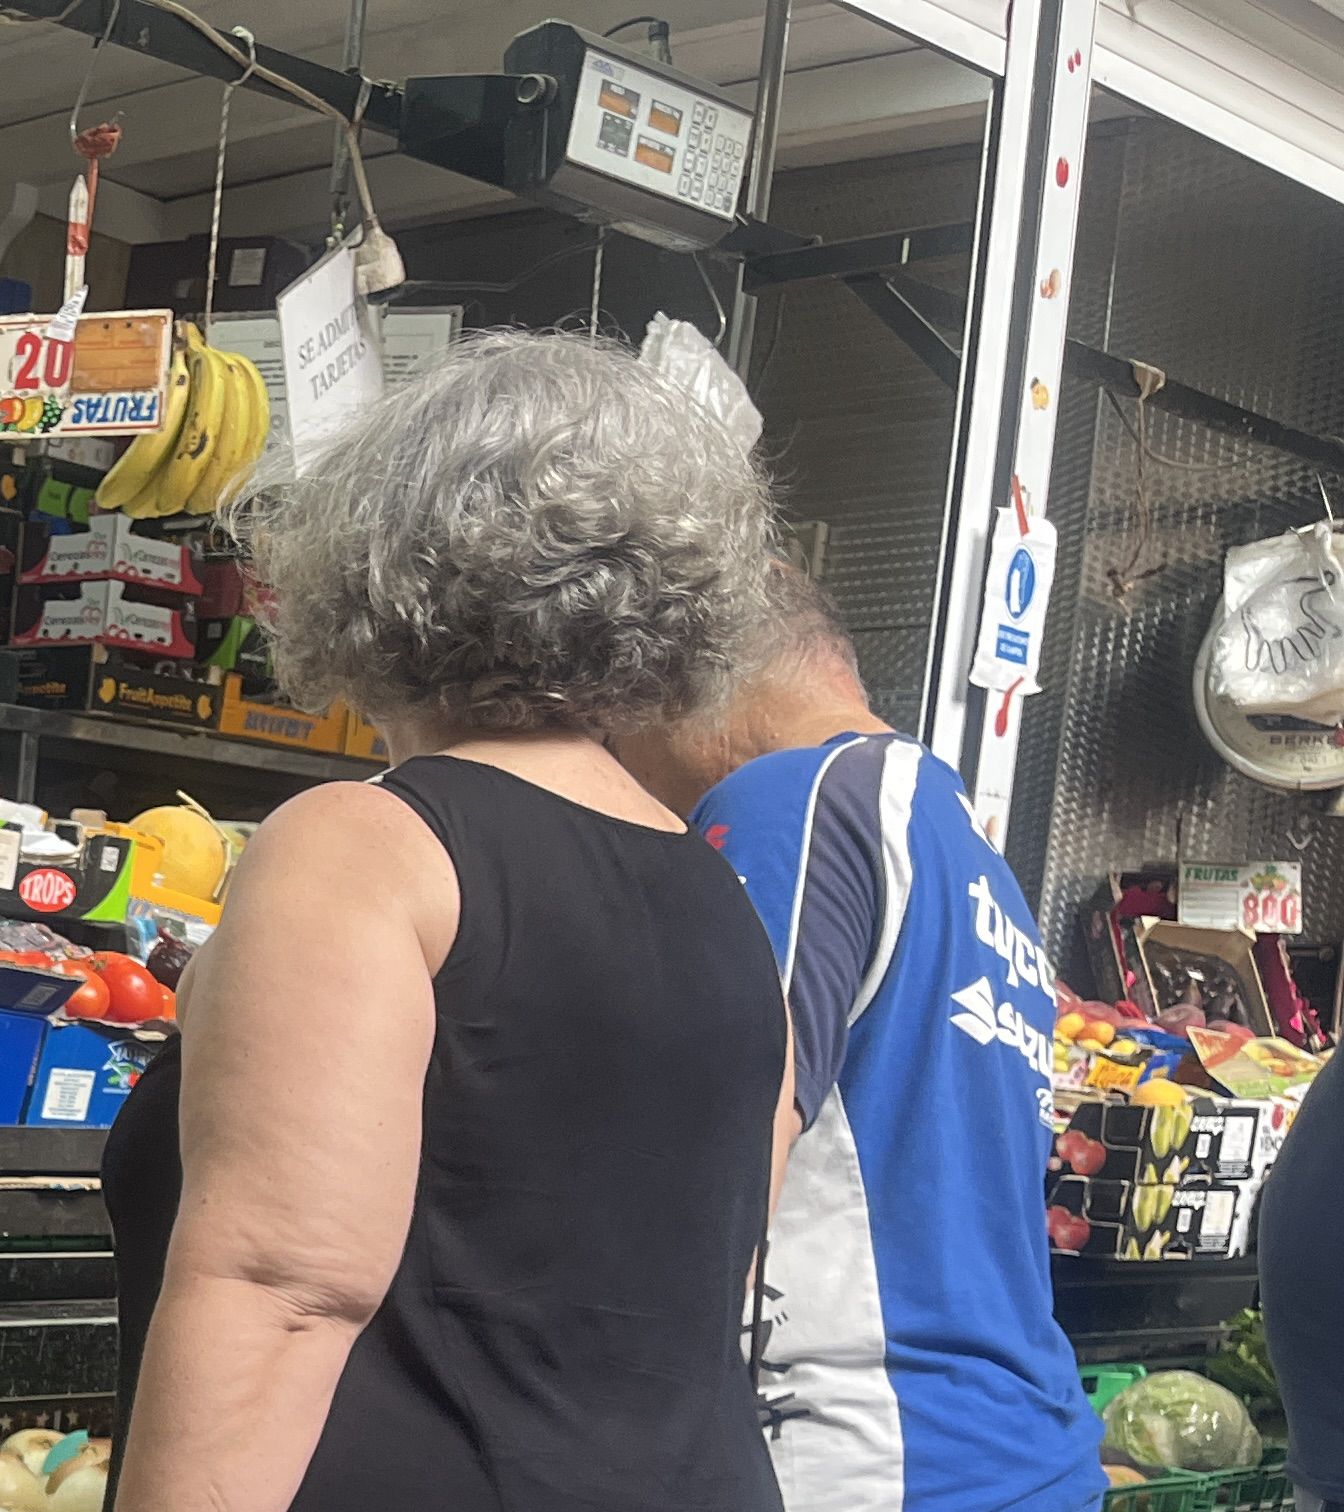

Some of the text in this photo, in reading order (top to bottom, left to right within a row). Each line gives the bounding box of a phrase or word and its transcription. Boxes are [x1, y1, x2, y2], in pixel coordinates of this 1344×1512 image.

[14, 331, 75, 391] 20
[71, 395, 159, 424] FRUTAS
[20, 872, 76, 906] TROPS
[1185, 866, 1239, 882] FRUTAS
[1243, 892, 1297, 928] 800
